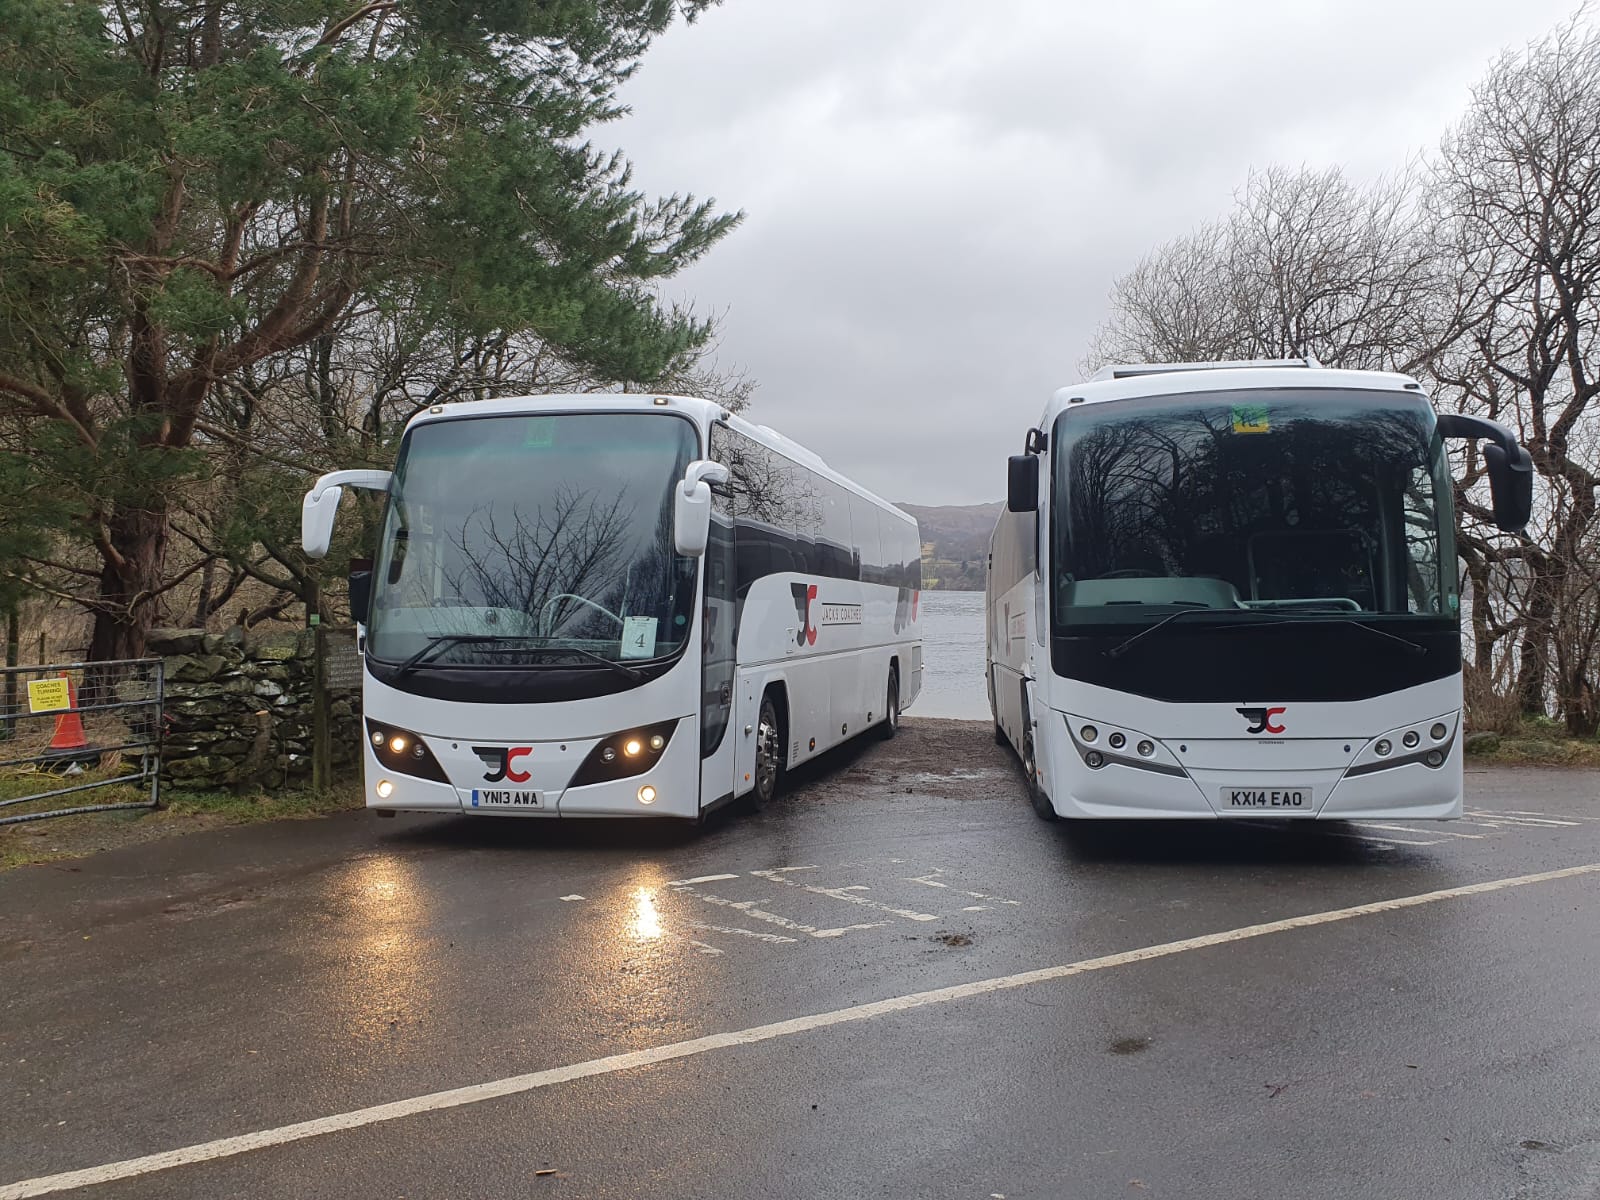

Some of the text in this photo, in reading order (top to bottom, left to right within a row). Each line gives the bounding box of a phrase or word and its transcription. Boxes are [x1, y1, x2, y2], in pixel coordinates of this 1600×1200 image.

[822, 607, 838, 621] JACKS
[634, 633, 646, 648] 4
[483, 791, 538, 805] YN13 AWA
[1231, 791, 1302, 806] KX14 EAO
